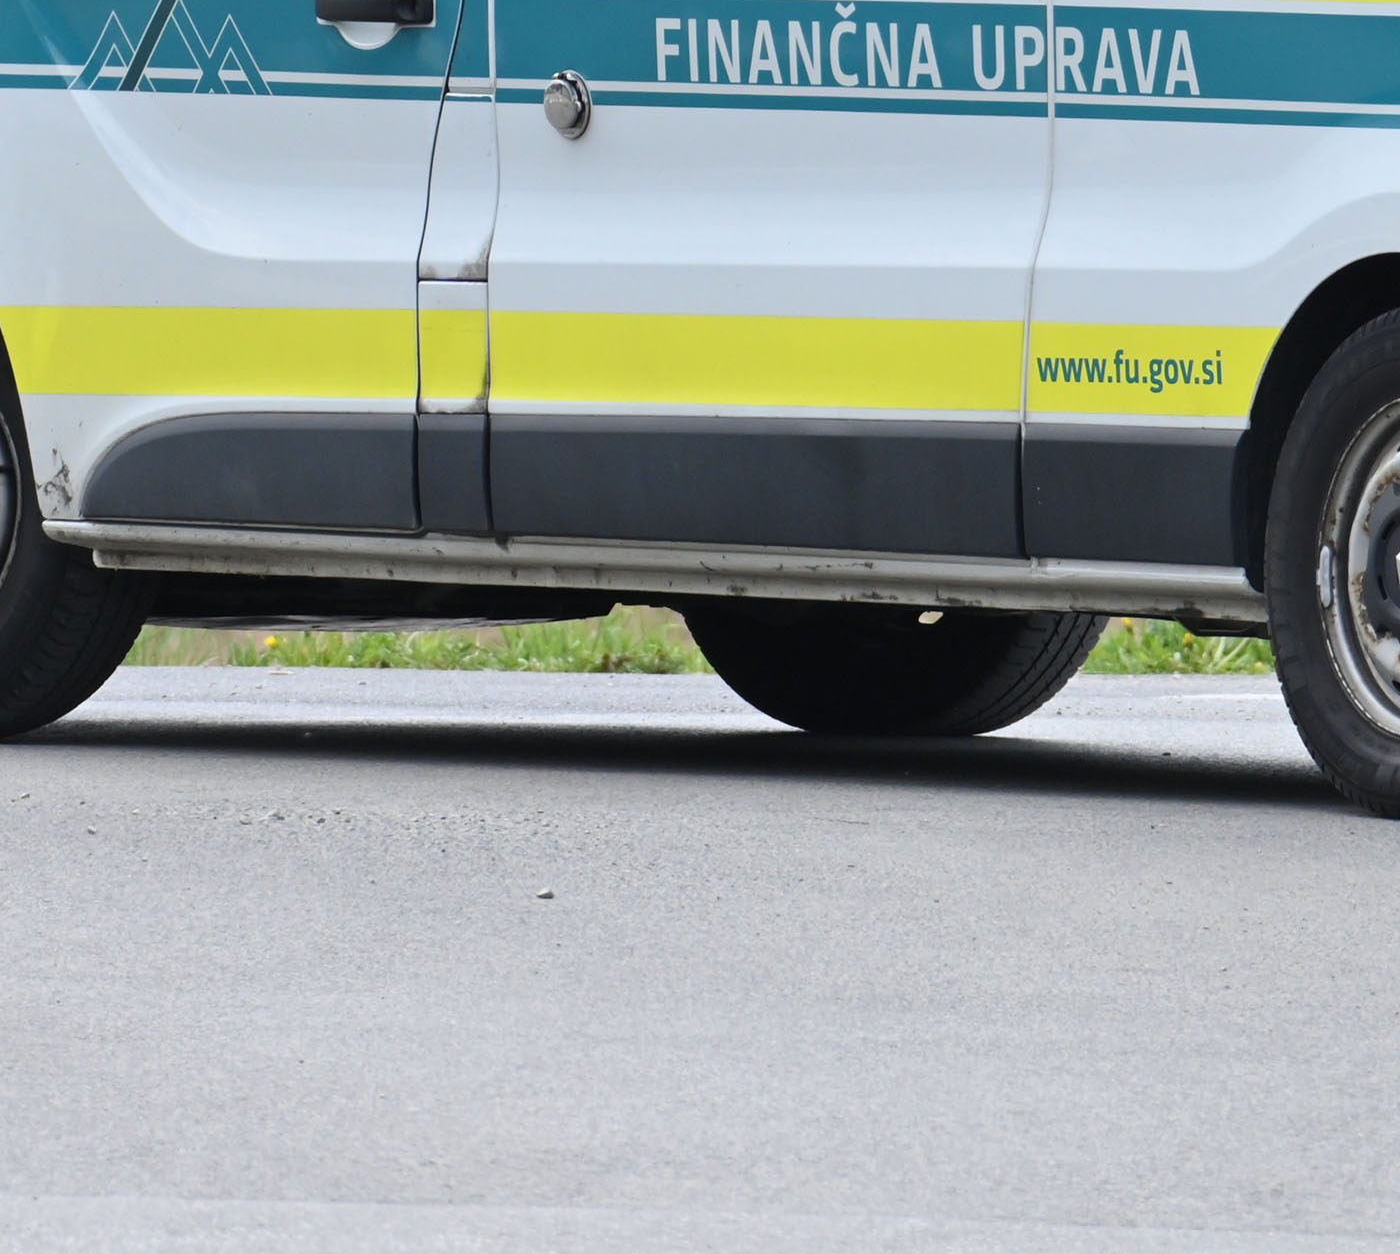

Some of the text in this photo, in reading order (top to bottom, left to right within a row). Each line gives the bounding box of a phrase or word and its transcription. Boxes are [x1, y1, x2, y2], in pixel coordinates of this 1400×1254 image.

[655, 2, 1201, 96] FINANČNA UPRAVA
[1036, 349, 1223, 394] www.fu.gov.si
